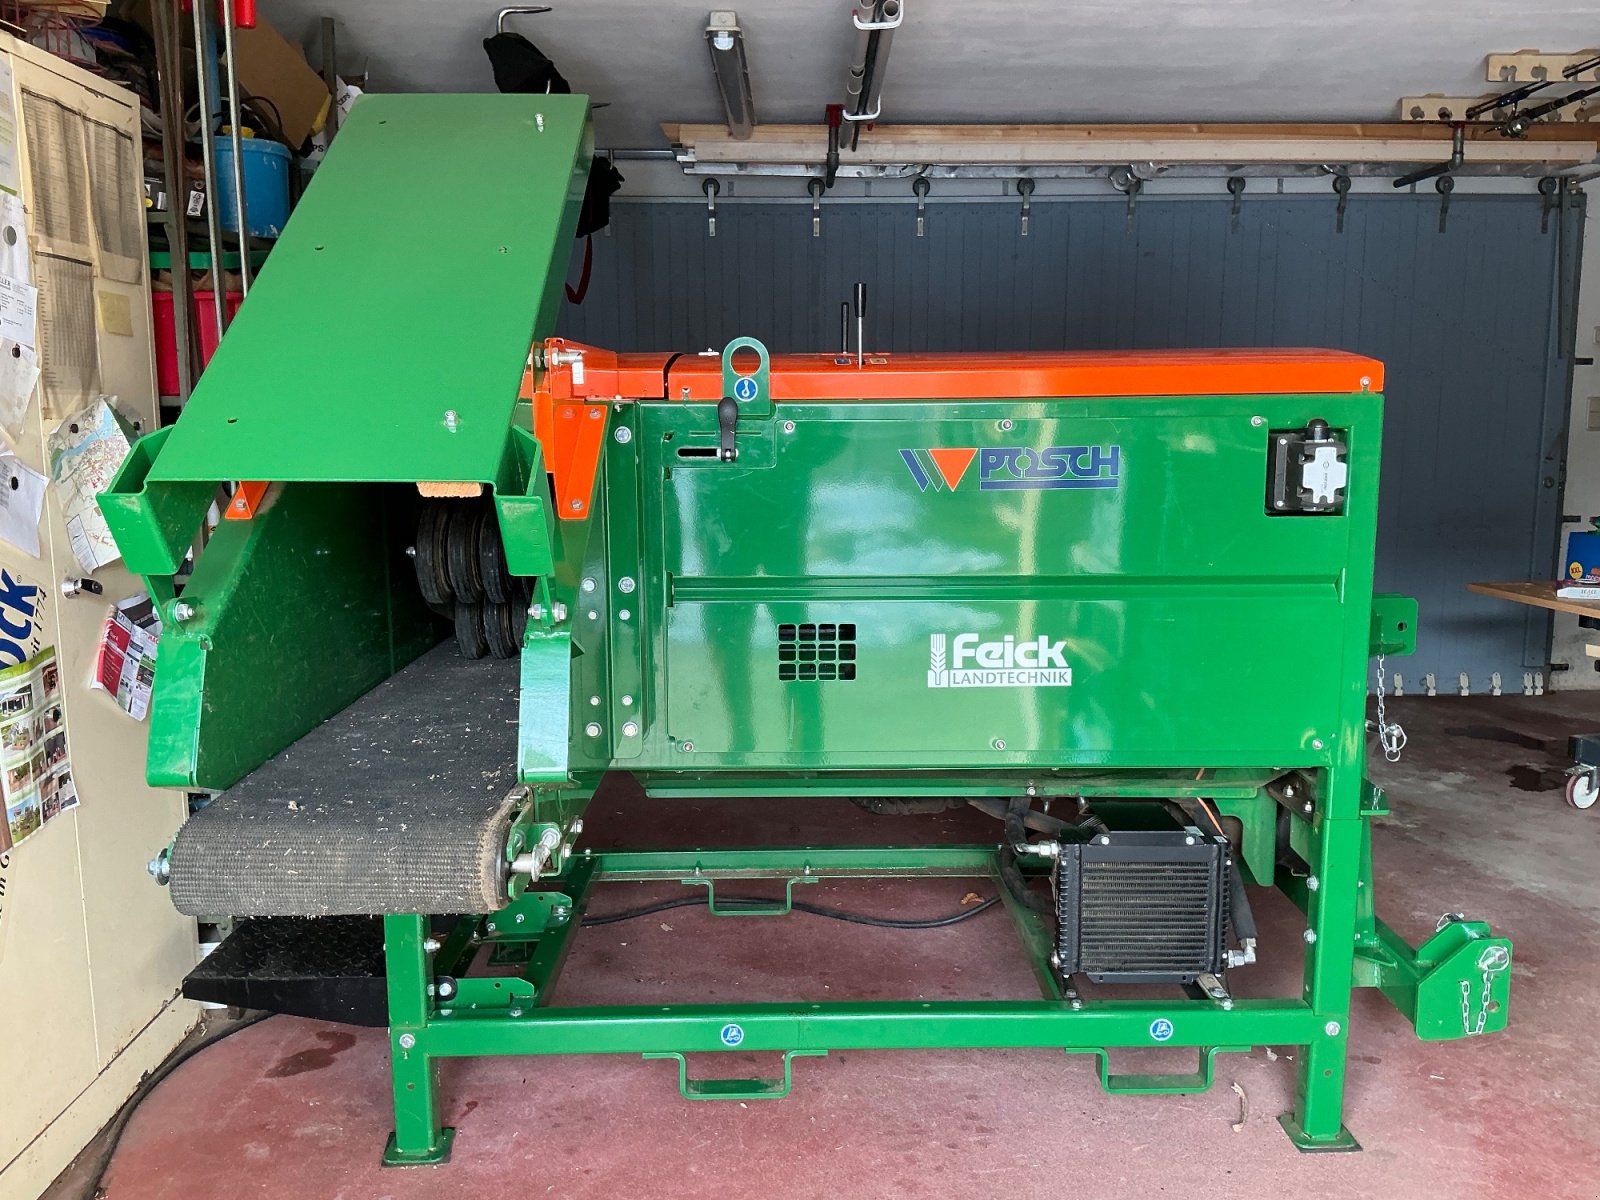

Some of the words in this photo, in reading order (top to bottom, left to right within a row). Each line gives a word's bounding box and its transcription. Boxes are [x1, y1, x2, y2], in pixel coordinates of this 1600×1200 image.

[979, 445, 1120, 478] POSCH
[952, 632, 1069, 669] Feick
[952, 671, 1069, 685] LANDTECHNIK
